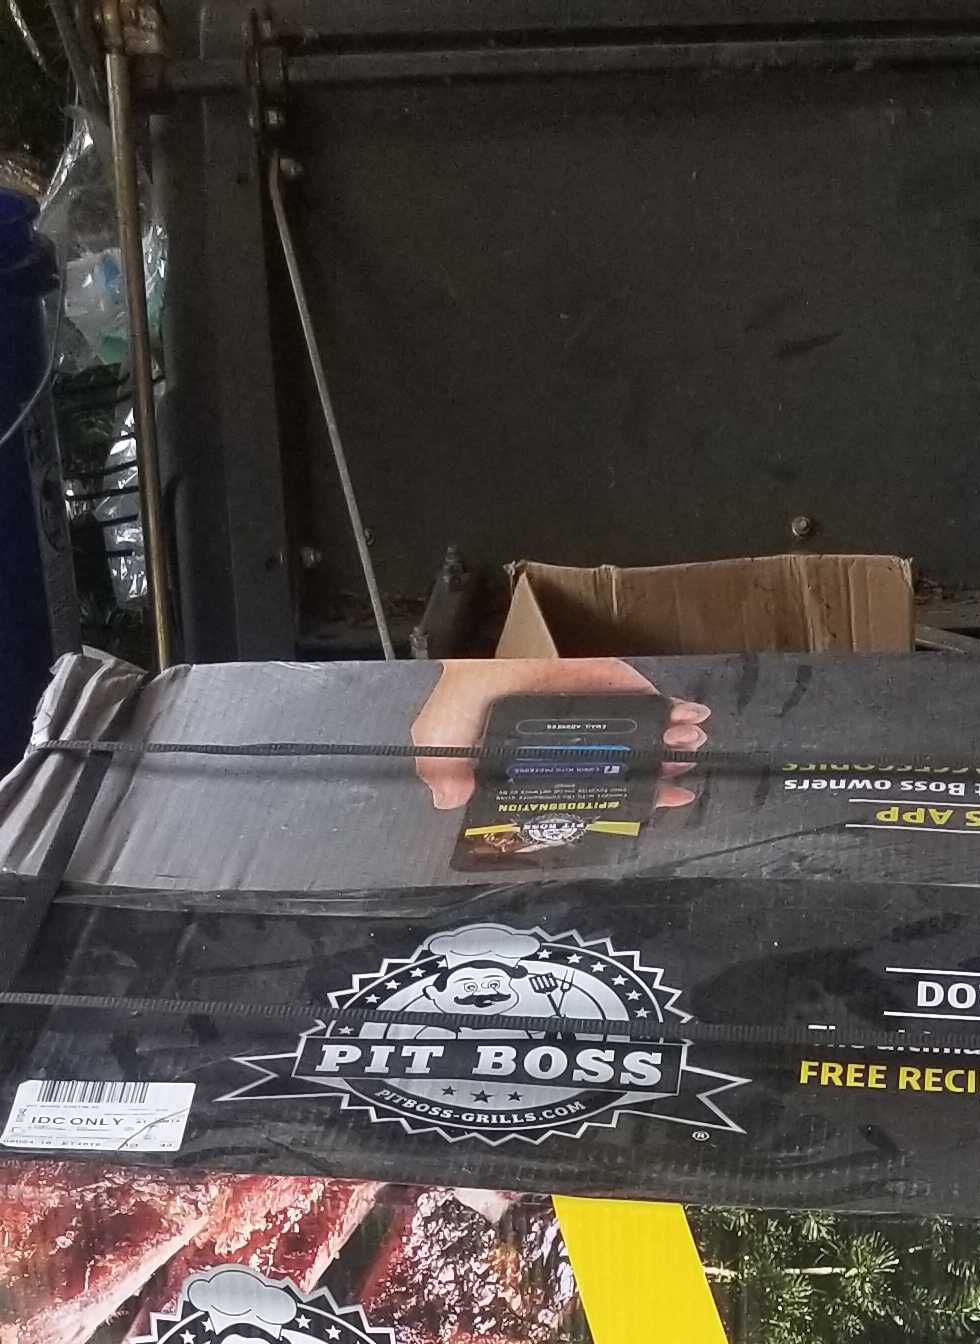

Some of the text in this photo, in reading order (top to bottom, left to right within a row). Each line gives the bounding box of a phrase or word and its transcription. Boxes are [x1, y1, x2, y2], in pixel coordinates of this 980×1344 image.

[784, 778, 892, 792] owners
[900, 780, 966, 796] Boss
[876, 806, 955, 824] APP
[314, 1043, 665, 1086] PIT BOSS
[800, 1060, 888, 1090] FREE
[373, 1087, 588, 1126] PITBOSS-GRILLS.COM
[31, 1116, 67, 1126] IDC
[69, 1117, 125, 1126] ONLY
